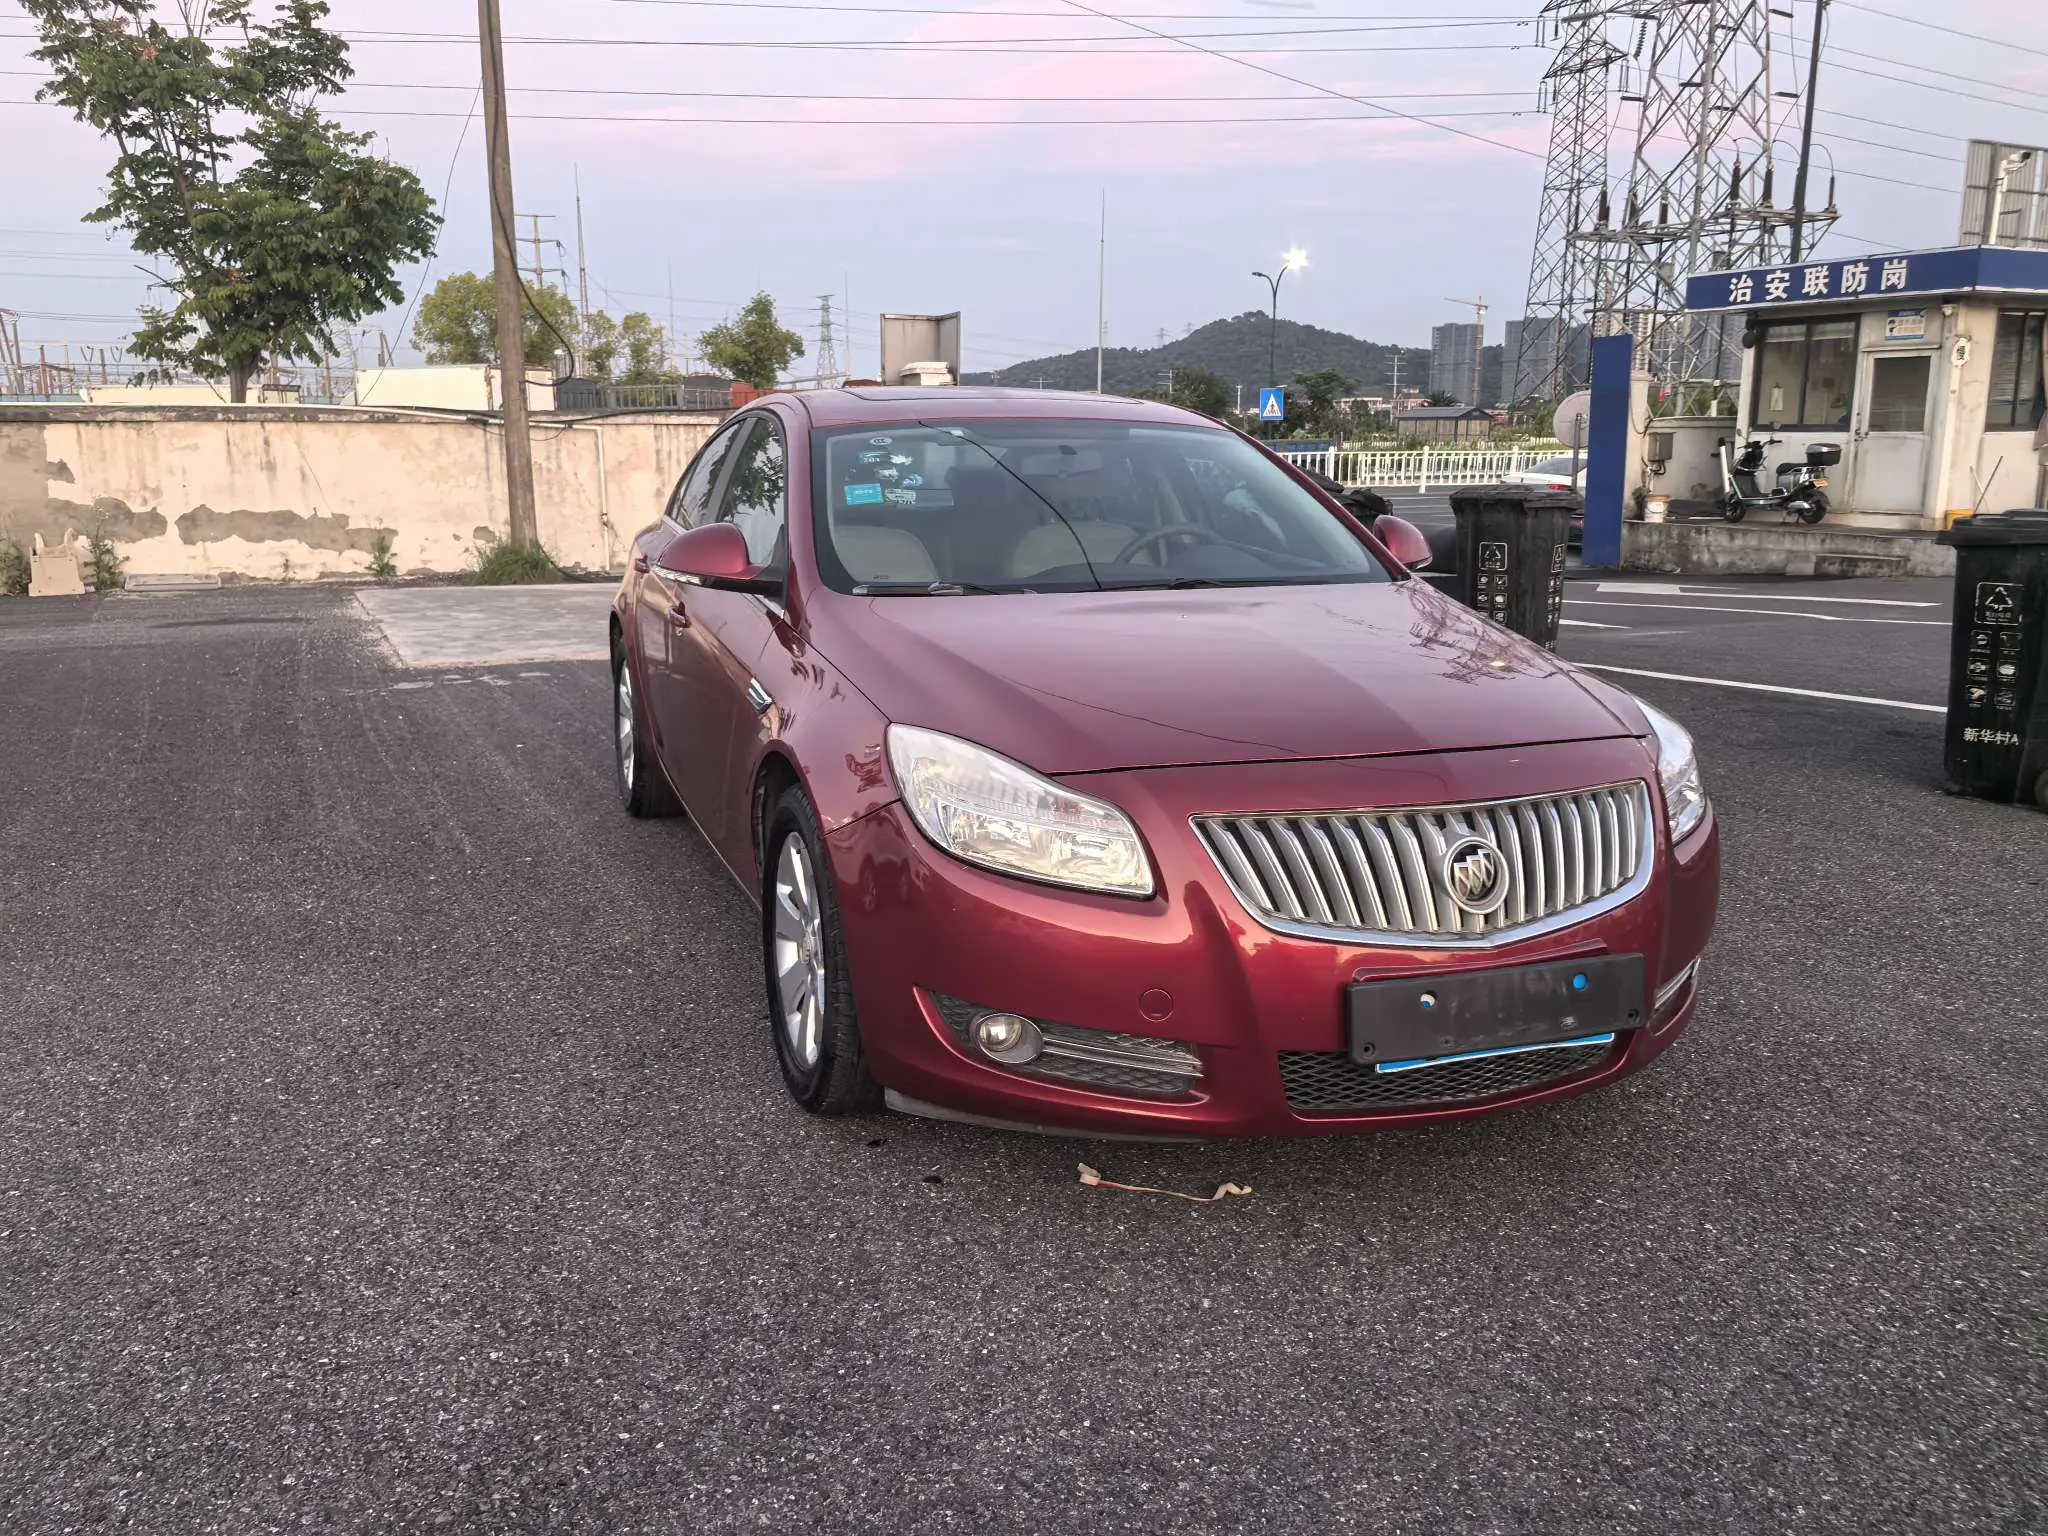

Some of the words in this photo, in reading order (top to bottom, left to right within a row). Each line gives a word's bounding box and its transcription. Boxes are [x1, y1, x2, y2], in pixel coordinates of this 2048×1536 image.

[1728, 259, 1908, 303] 治安联防岗
[1963, 727, 2019, 746] 新华村A
